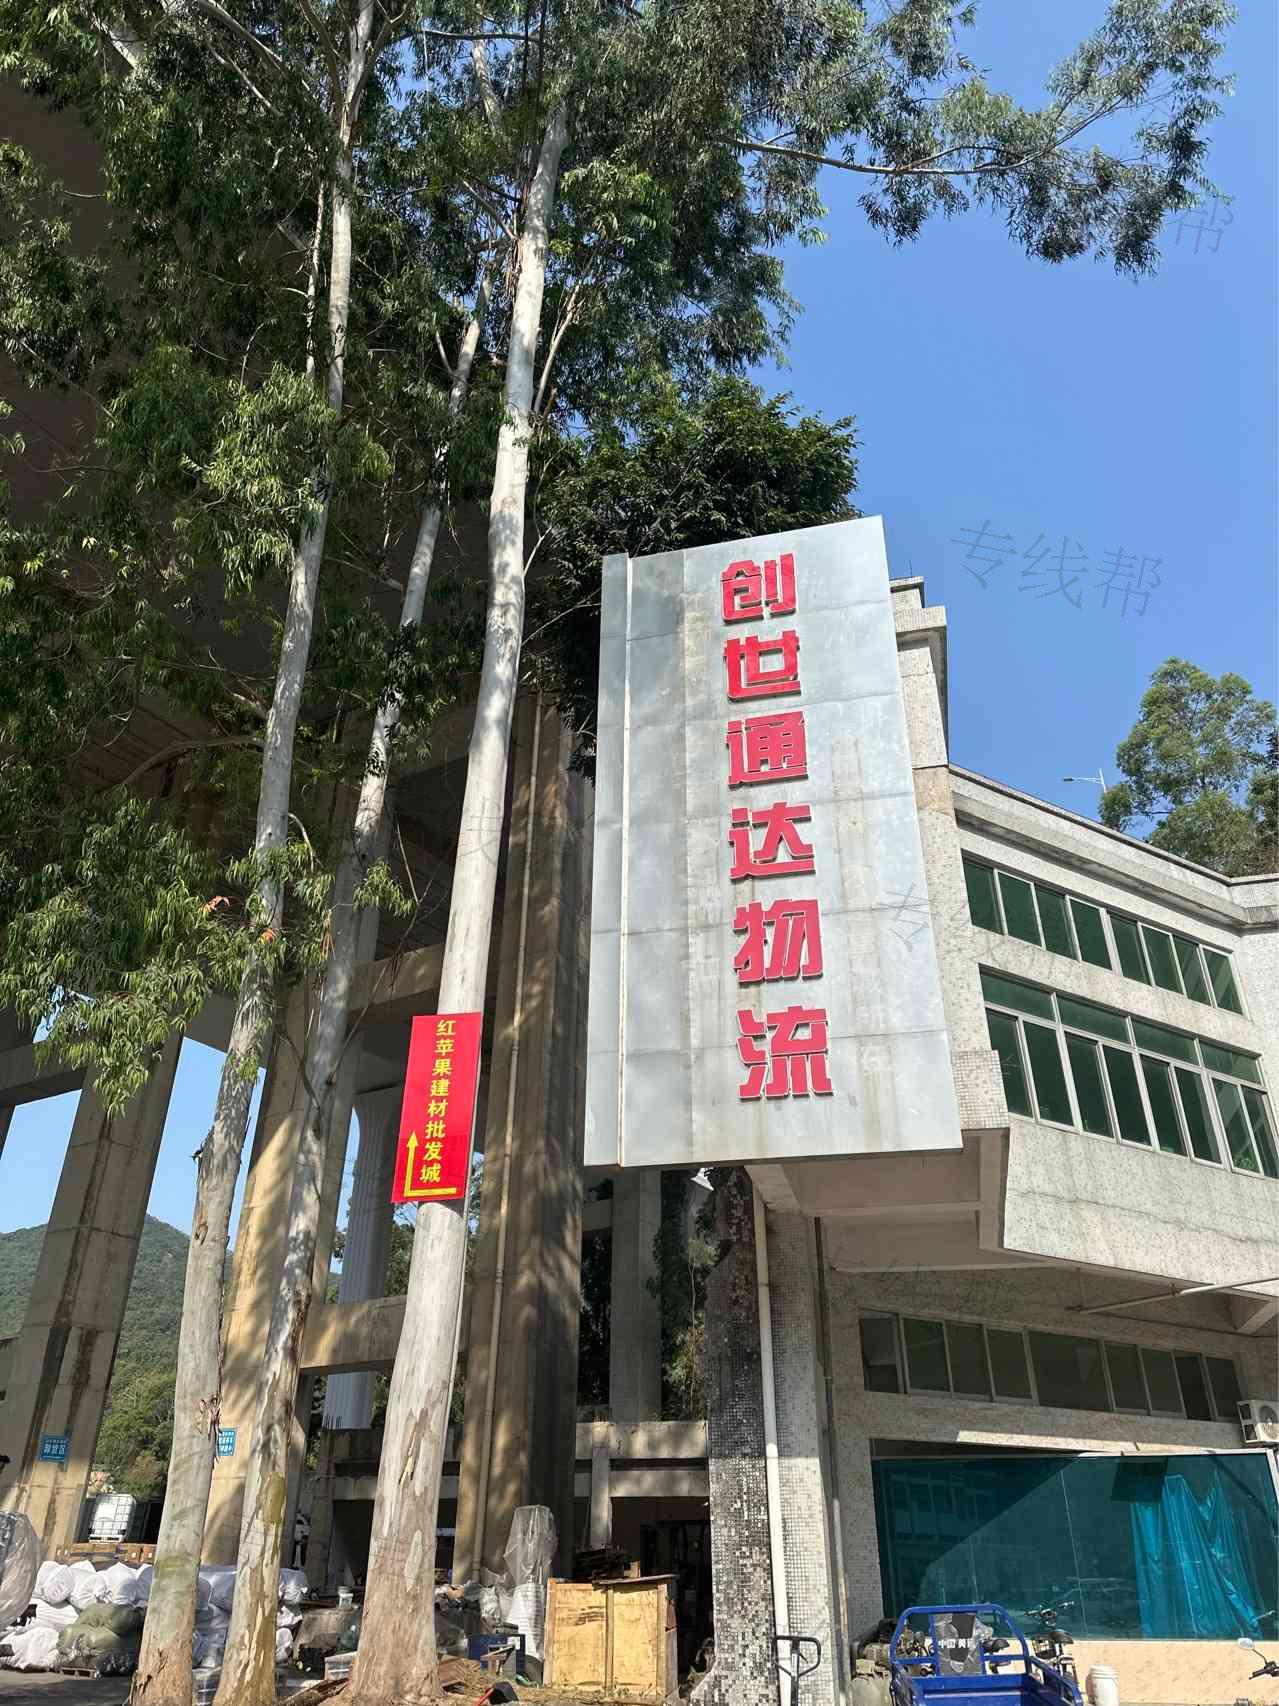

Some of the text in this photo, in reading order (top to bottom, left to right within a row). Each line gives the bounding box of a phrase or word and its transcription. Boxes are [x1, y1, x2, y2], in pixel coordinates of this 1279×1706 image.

[720, 552, 833, 1101] 创世通达物流
[419, 1019, 457, 1184] 红苹果建材批发城
